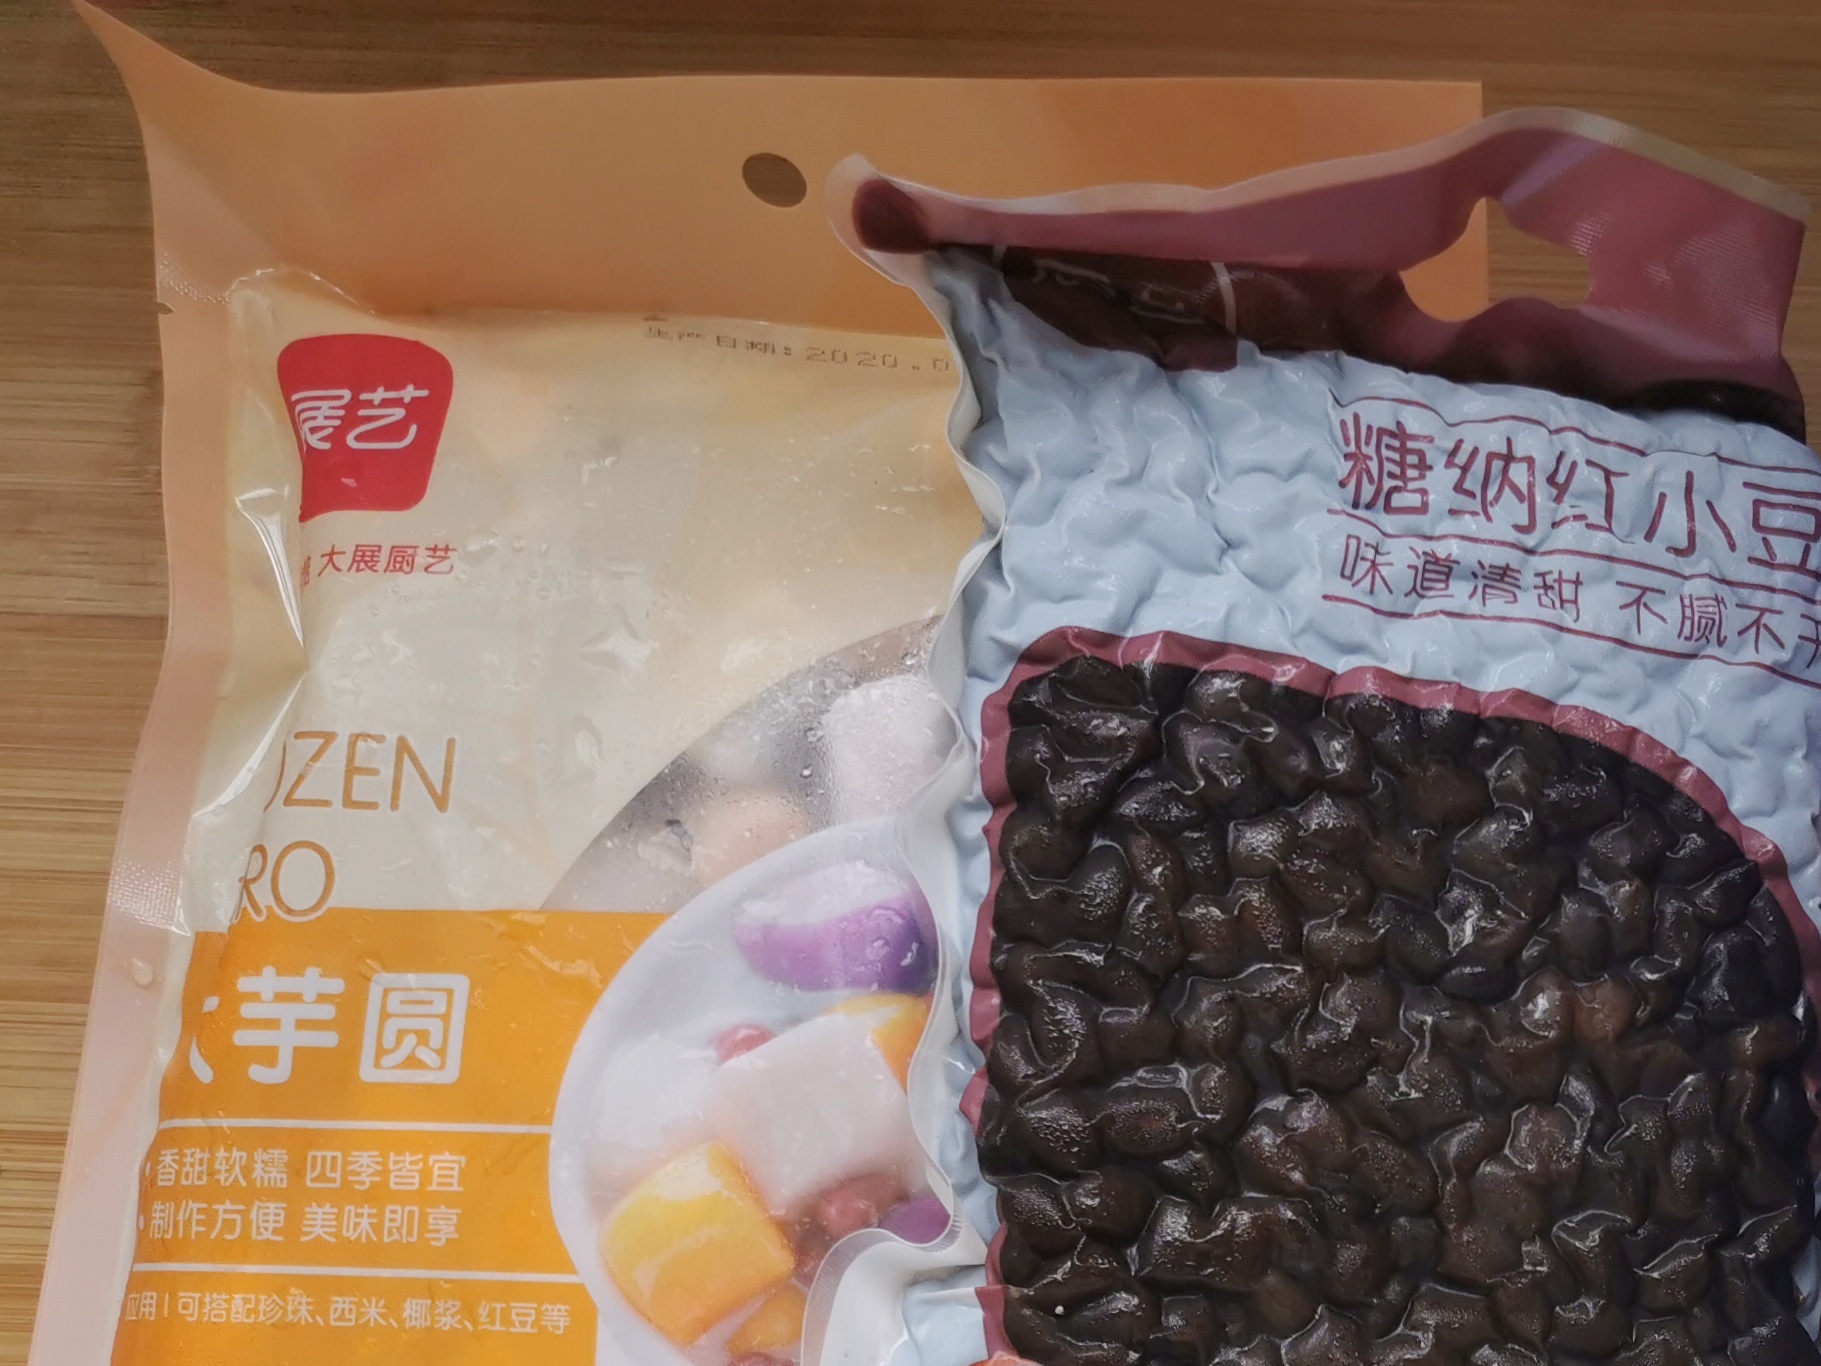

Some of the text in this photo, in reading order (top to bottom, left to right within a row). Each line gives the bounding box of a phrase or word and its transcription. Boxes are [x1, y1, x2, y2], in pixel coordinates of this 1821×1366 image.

[291, 384, 430, 454] 展艺
[317, 543, 458, 578] 大展厨艺
[1339, 534, 1583, 623] 味道清甜
[262, 730, 457, 814] ZEN
[189, 965, 471, 1085] 芋圆
[156, 1147, 467, 1193] 香甜软糯 四季皆宜
[149, 1199, 461, 1247] 制作方便 美味即享
